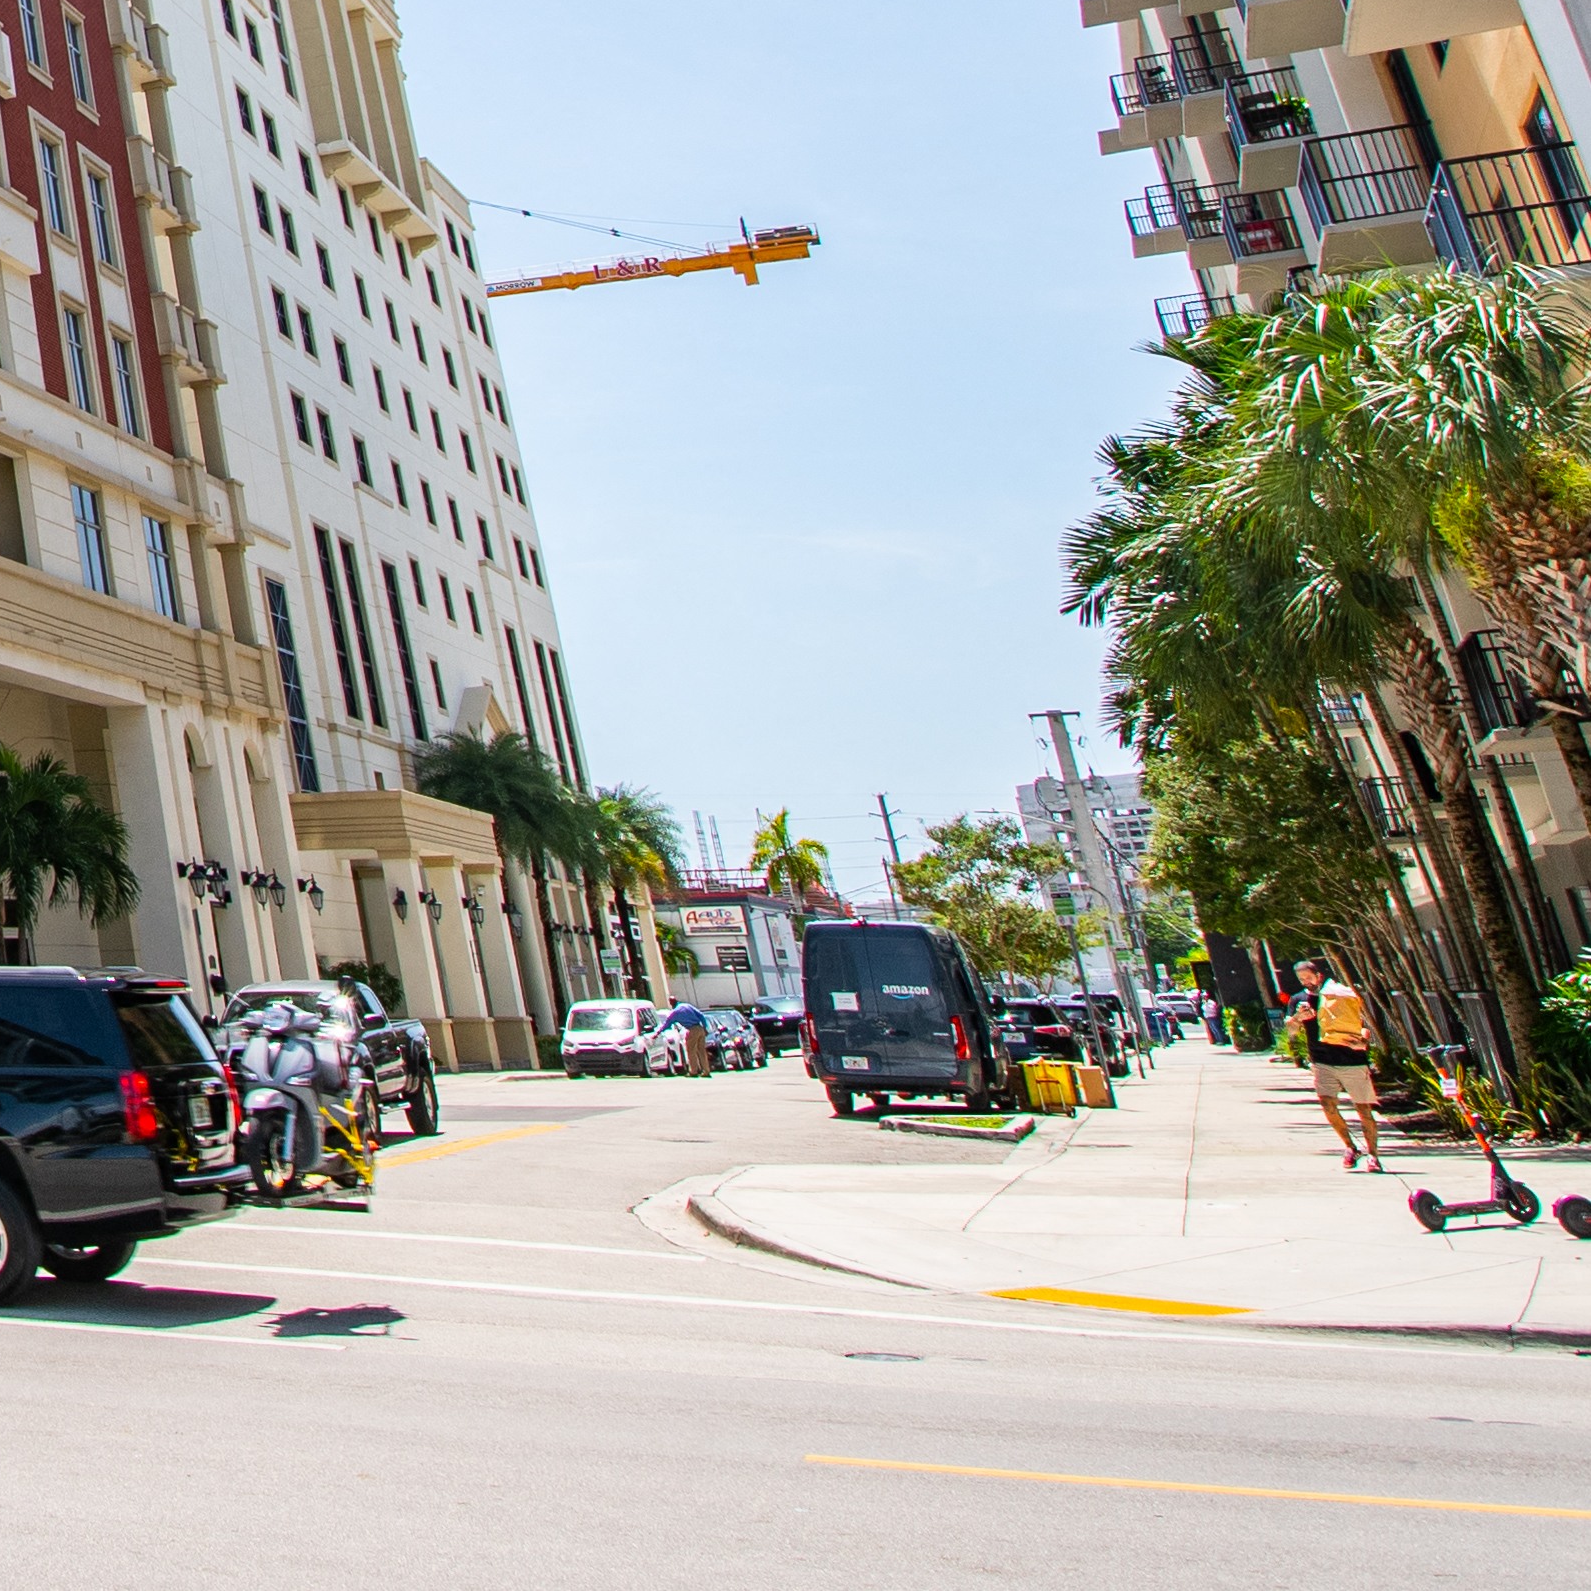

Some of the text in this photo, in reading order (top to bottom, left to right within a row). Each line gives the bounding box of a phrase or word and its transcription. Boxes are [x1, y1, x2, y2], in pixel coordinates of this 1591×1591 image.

[617, 260, 635, 277] &
[644, 257, 664, 273] R
[882, 984, 930, 996] amazon
